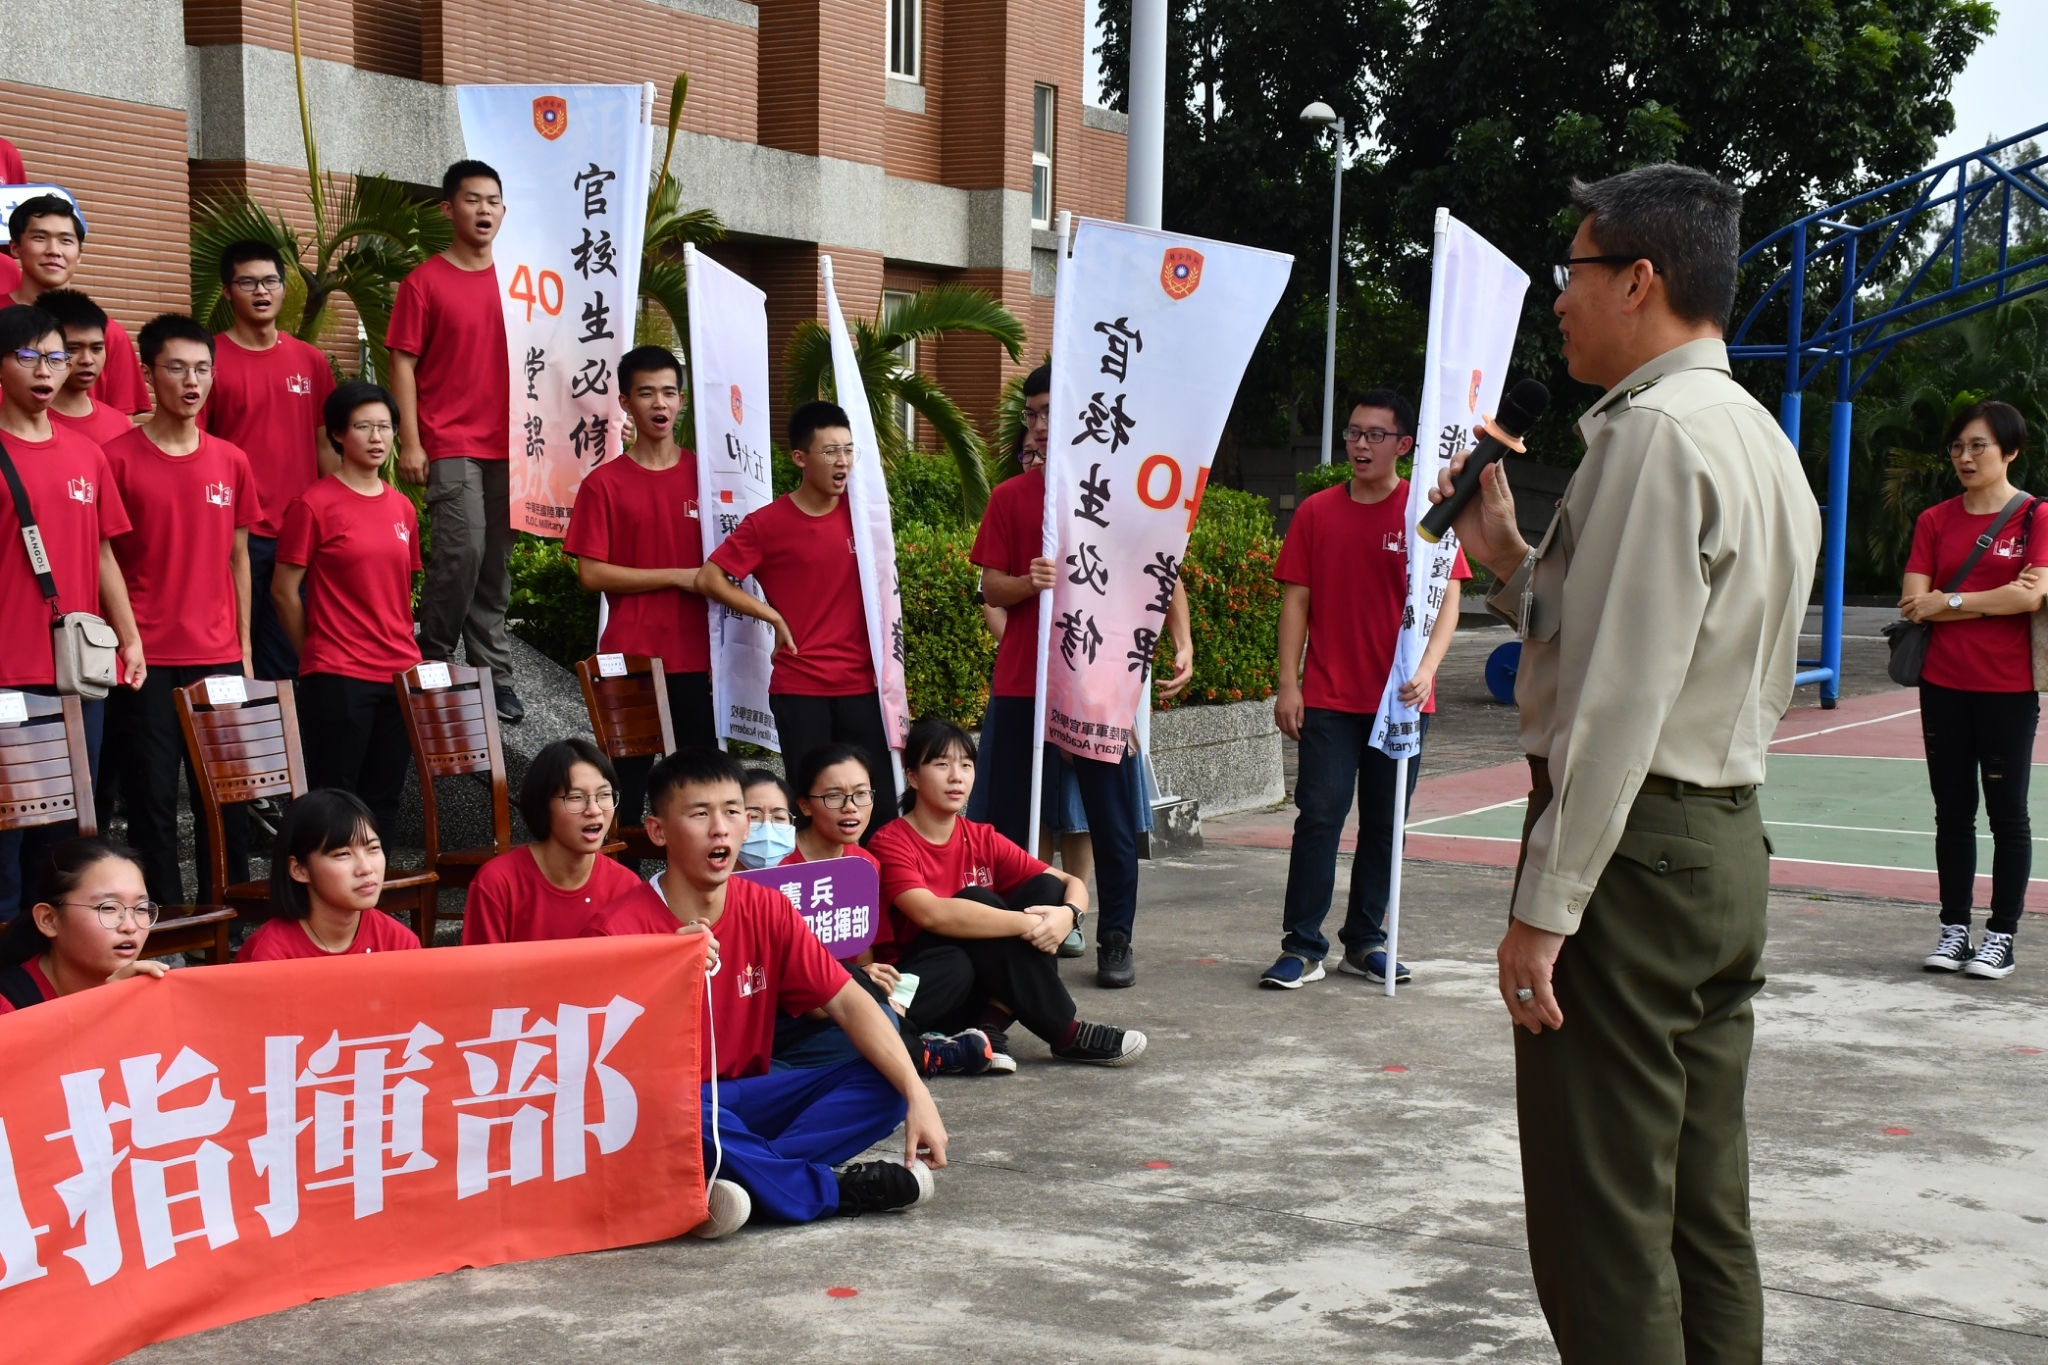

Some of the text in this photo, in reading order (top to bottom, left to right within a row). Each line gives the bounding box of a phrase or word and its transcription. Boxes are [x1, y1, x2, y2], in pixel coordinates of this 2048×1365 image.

[509, 264, 564, 463] 40 堂課
[570, 162, 618, 468] 官校生必修
[28, 529, 45, 570] KANGOL
[539, 518, 565, 533] Military
